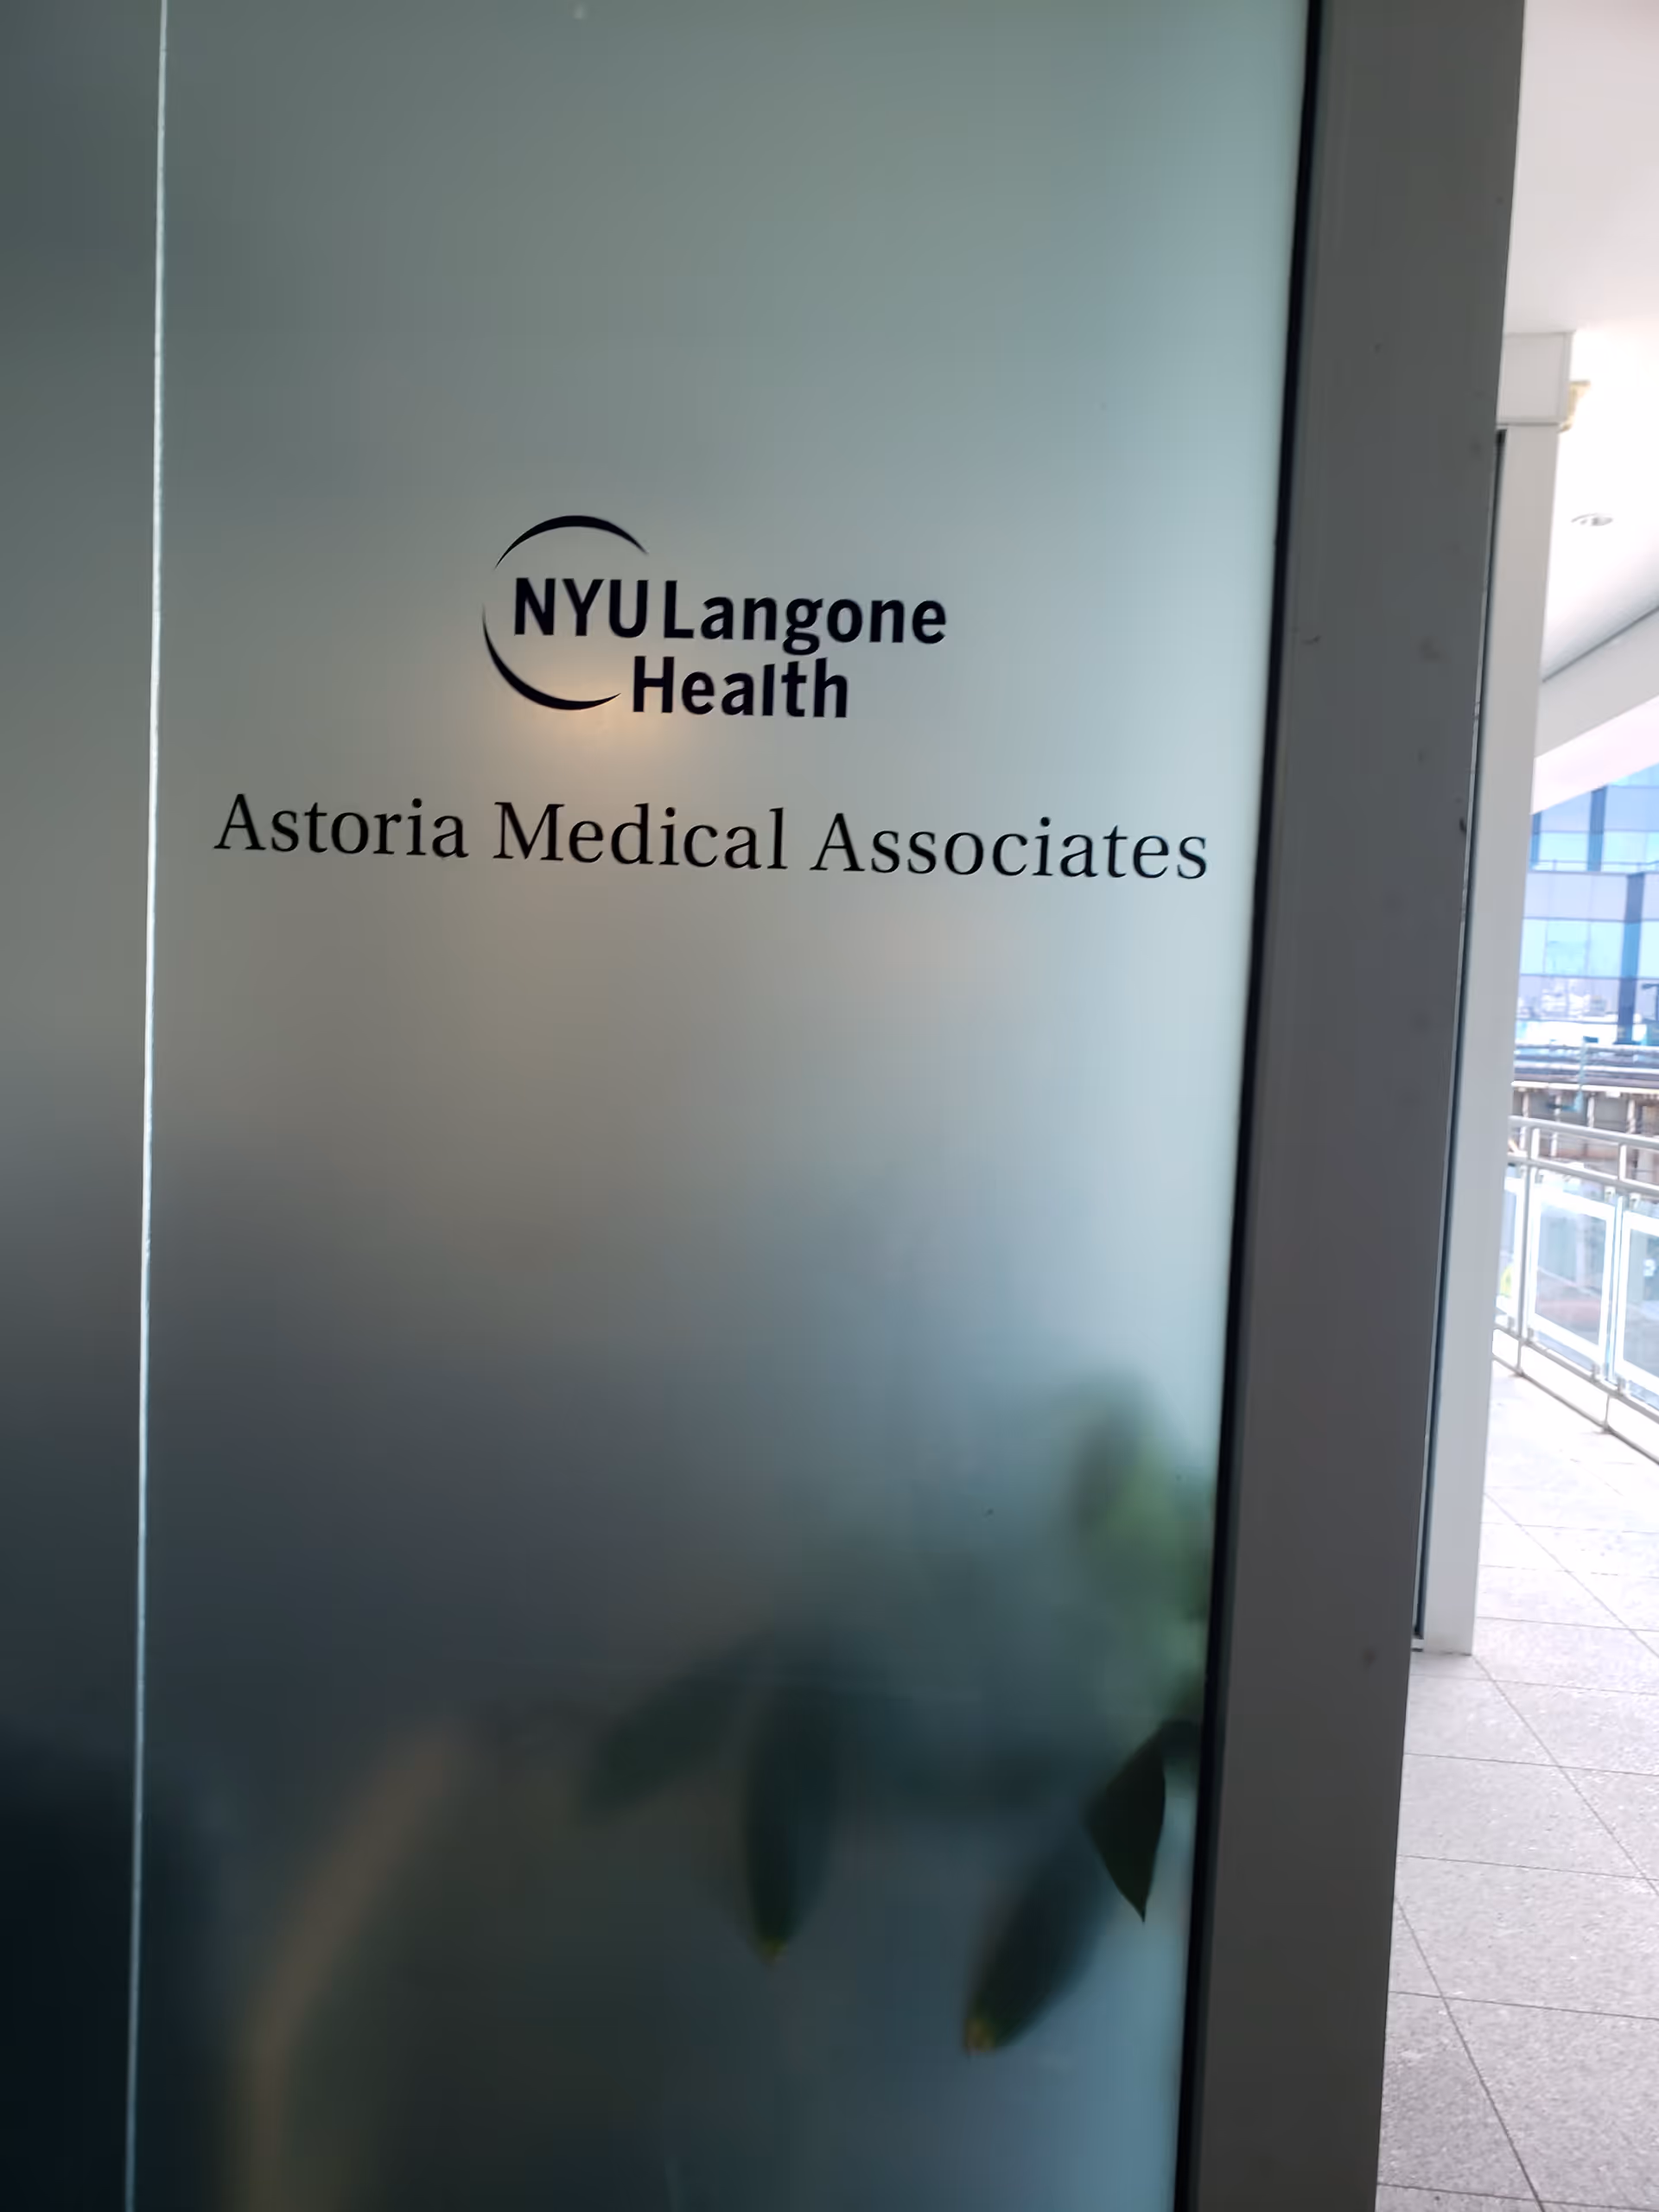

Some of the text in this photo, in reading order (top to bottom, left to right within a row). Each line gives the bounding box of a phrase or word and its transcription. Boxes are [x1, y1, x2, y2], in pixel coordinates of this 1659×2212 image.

[514, 576, 948, 657] NYU Langone
[632, 655, 849, 718] Health
[213, 792, 1209, 880] Astoria Medical Associates
